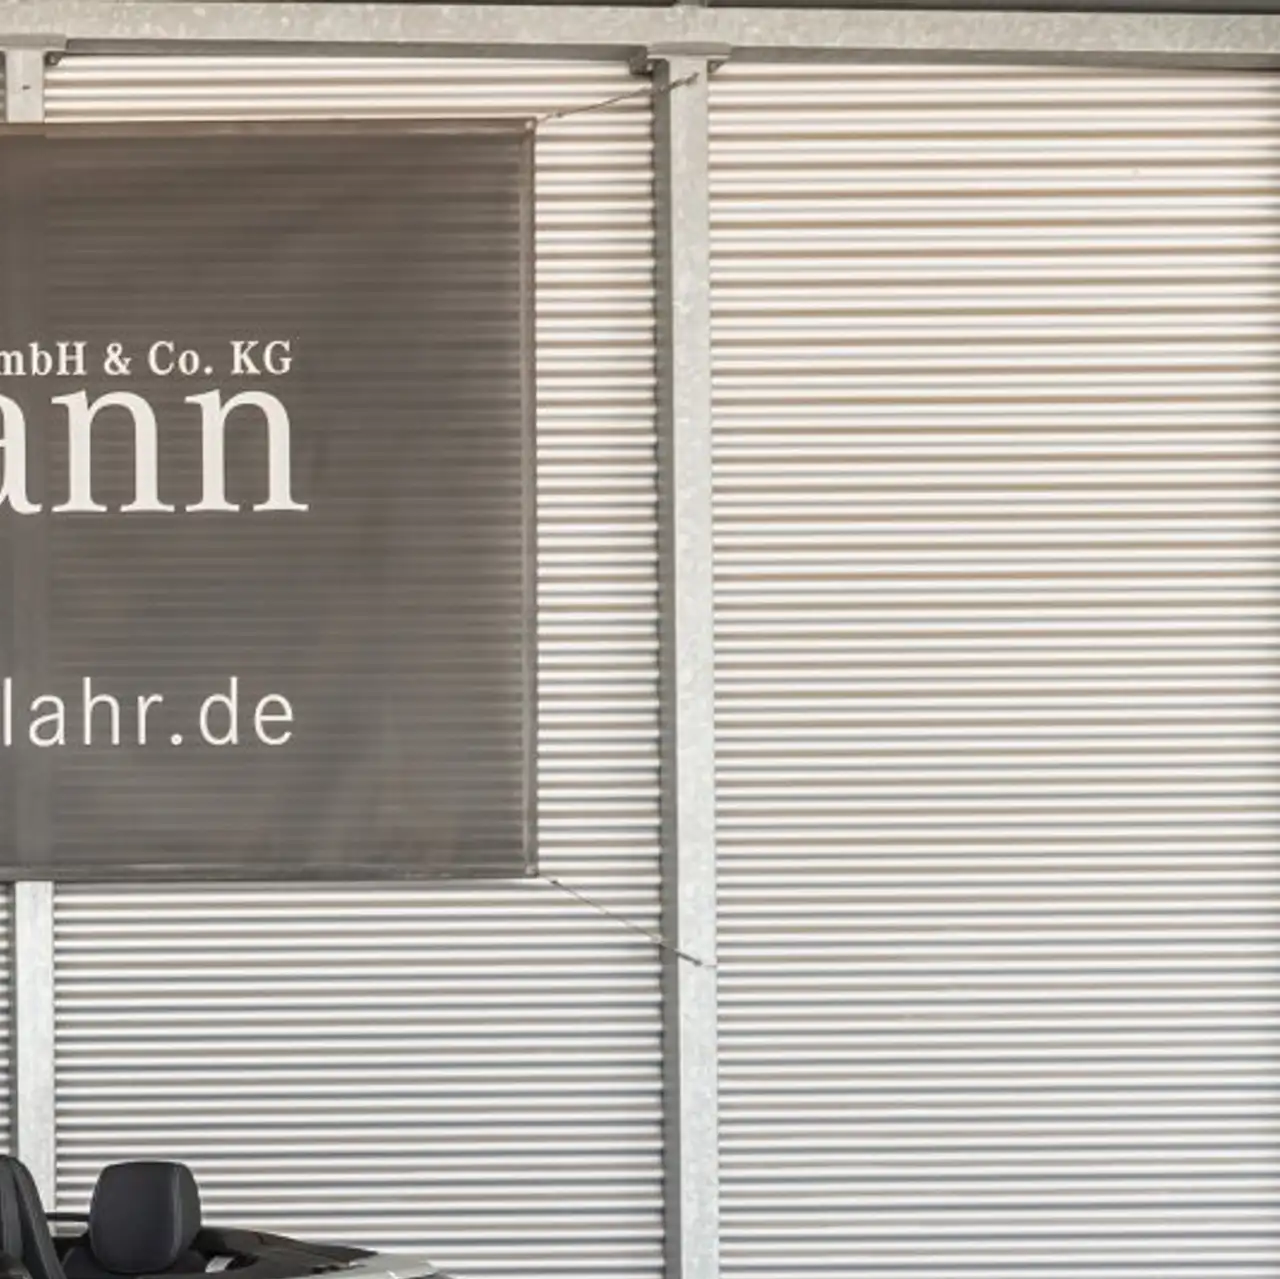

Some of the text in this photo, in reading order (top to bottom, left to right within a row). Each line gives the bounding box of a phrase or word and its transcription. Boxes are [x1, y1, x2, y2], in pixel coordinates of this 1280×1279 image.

[103, 342, 132, 376] &
[147, 341, 213, 376] Co.
[230, 341, 293, 375] KG
